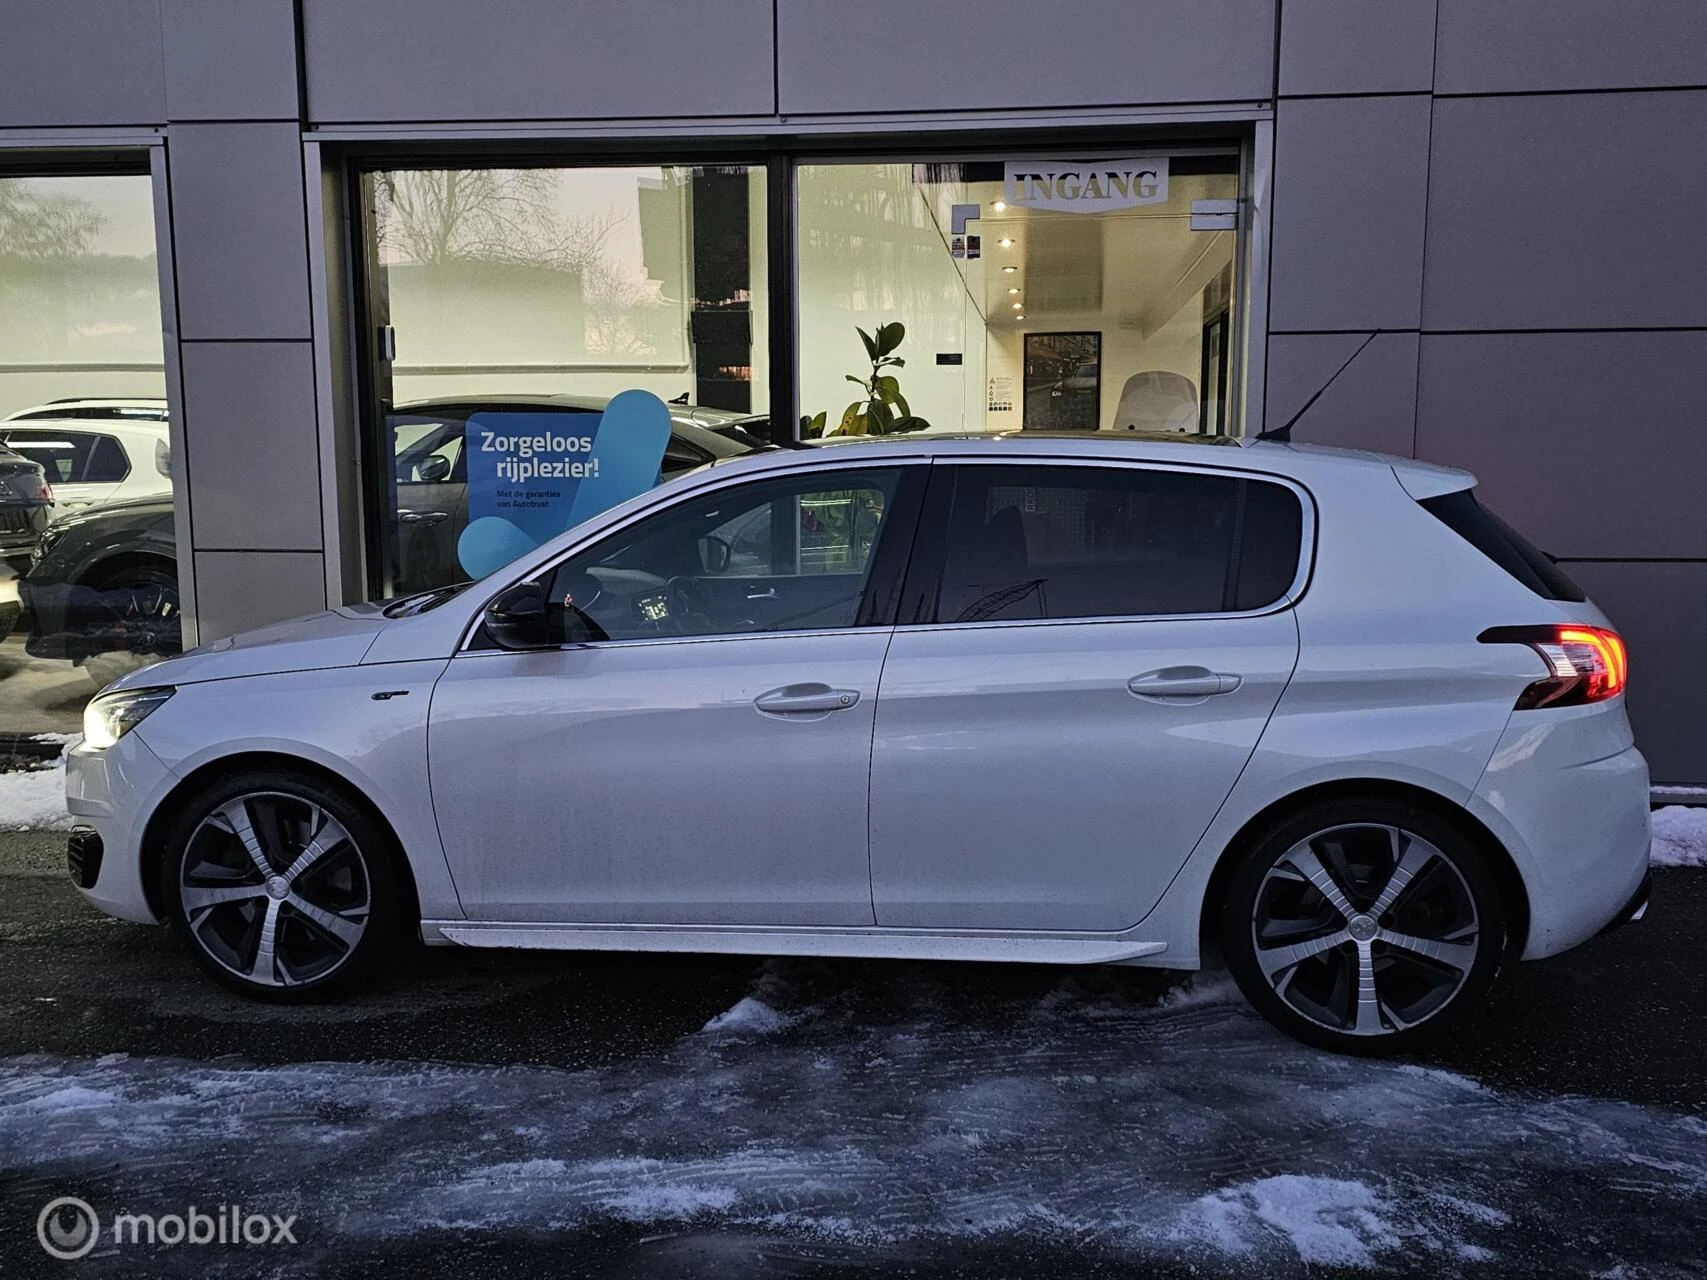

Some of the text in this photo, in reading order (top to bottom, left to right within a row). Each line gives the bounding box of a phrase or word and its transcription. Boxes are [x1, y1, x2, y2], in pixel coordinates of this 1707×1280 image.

[1013, 171, 1159, 201] INGANG
[481, 431, 592, 458] Zorgeloos
[496, 457, 600, 483] rijplezier!
[496, 490, 561, 500] Met de garanties
[512, 500, 549, 509] Autotrust
